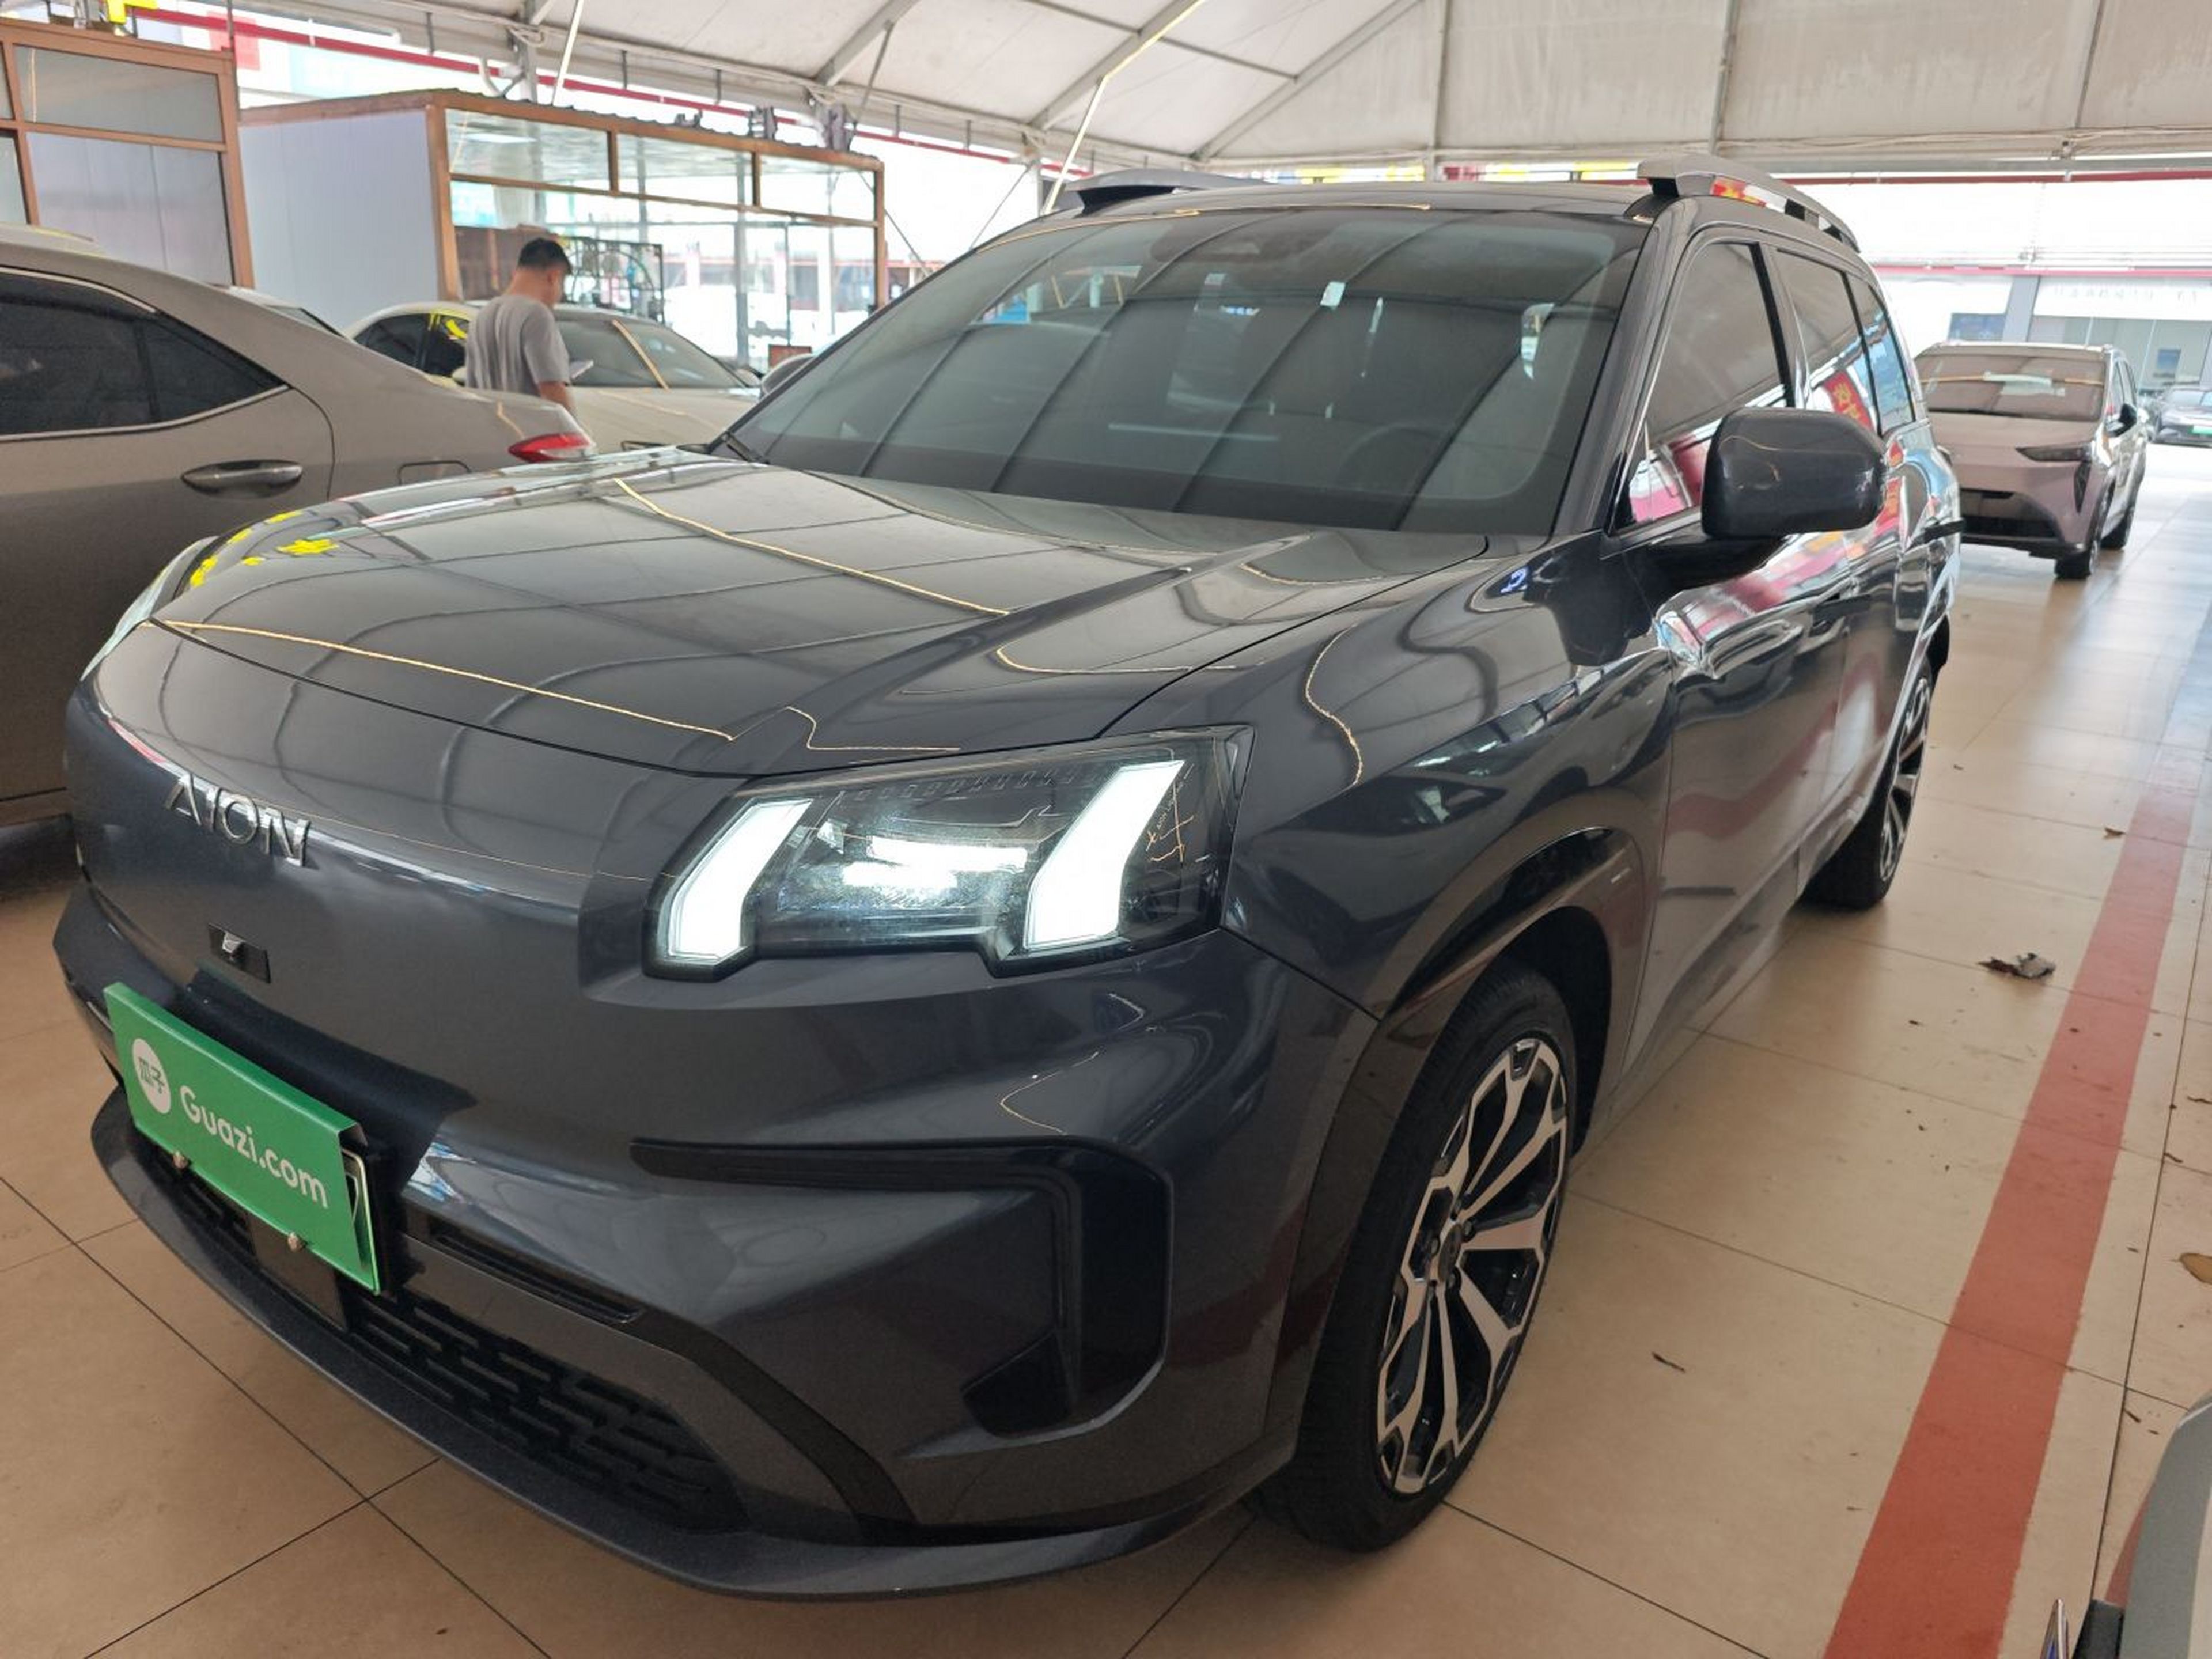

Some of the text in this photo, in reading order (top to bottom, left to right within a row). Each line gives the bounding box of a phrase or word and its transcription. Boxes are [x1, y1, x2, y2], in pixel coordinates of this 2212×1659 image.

[165, 773, 310, 866] AION
[138, 1056, 165, 1094] 瓜子
[180, 1085, 329, 1209] Guazi.com
